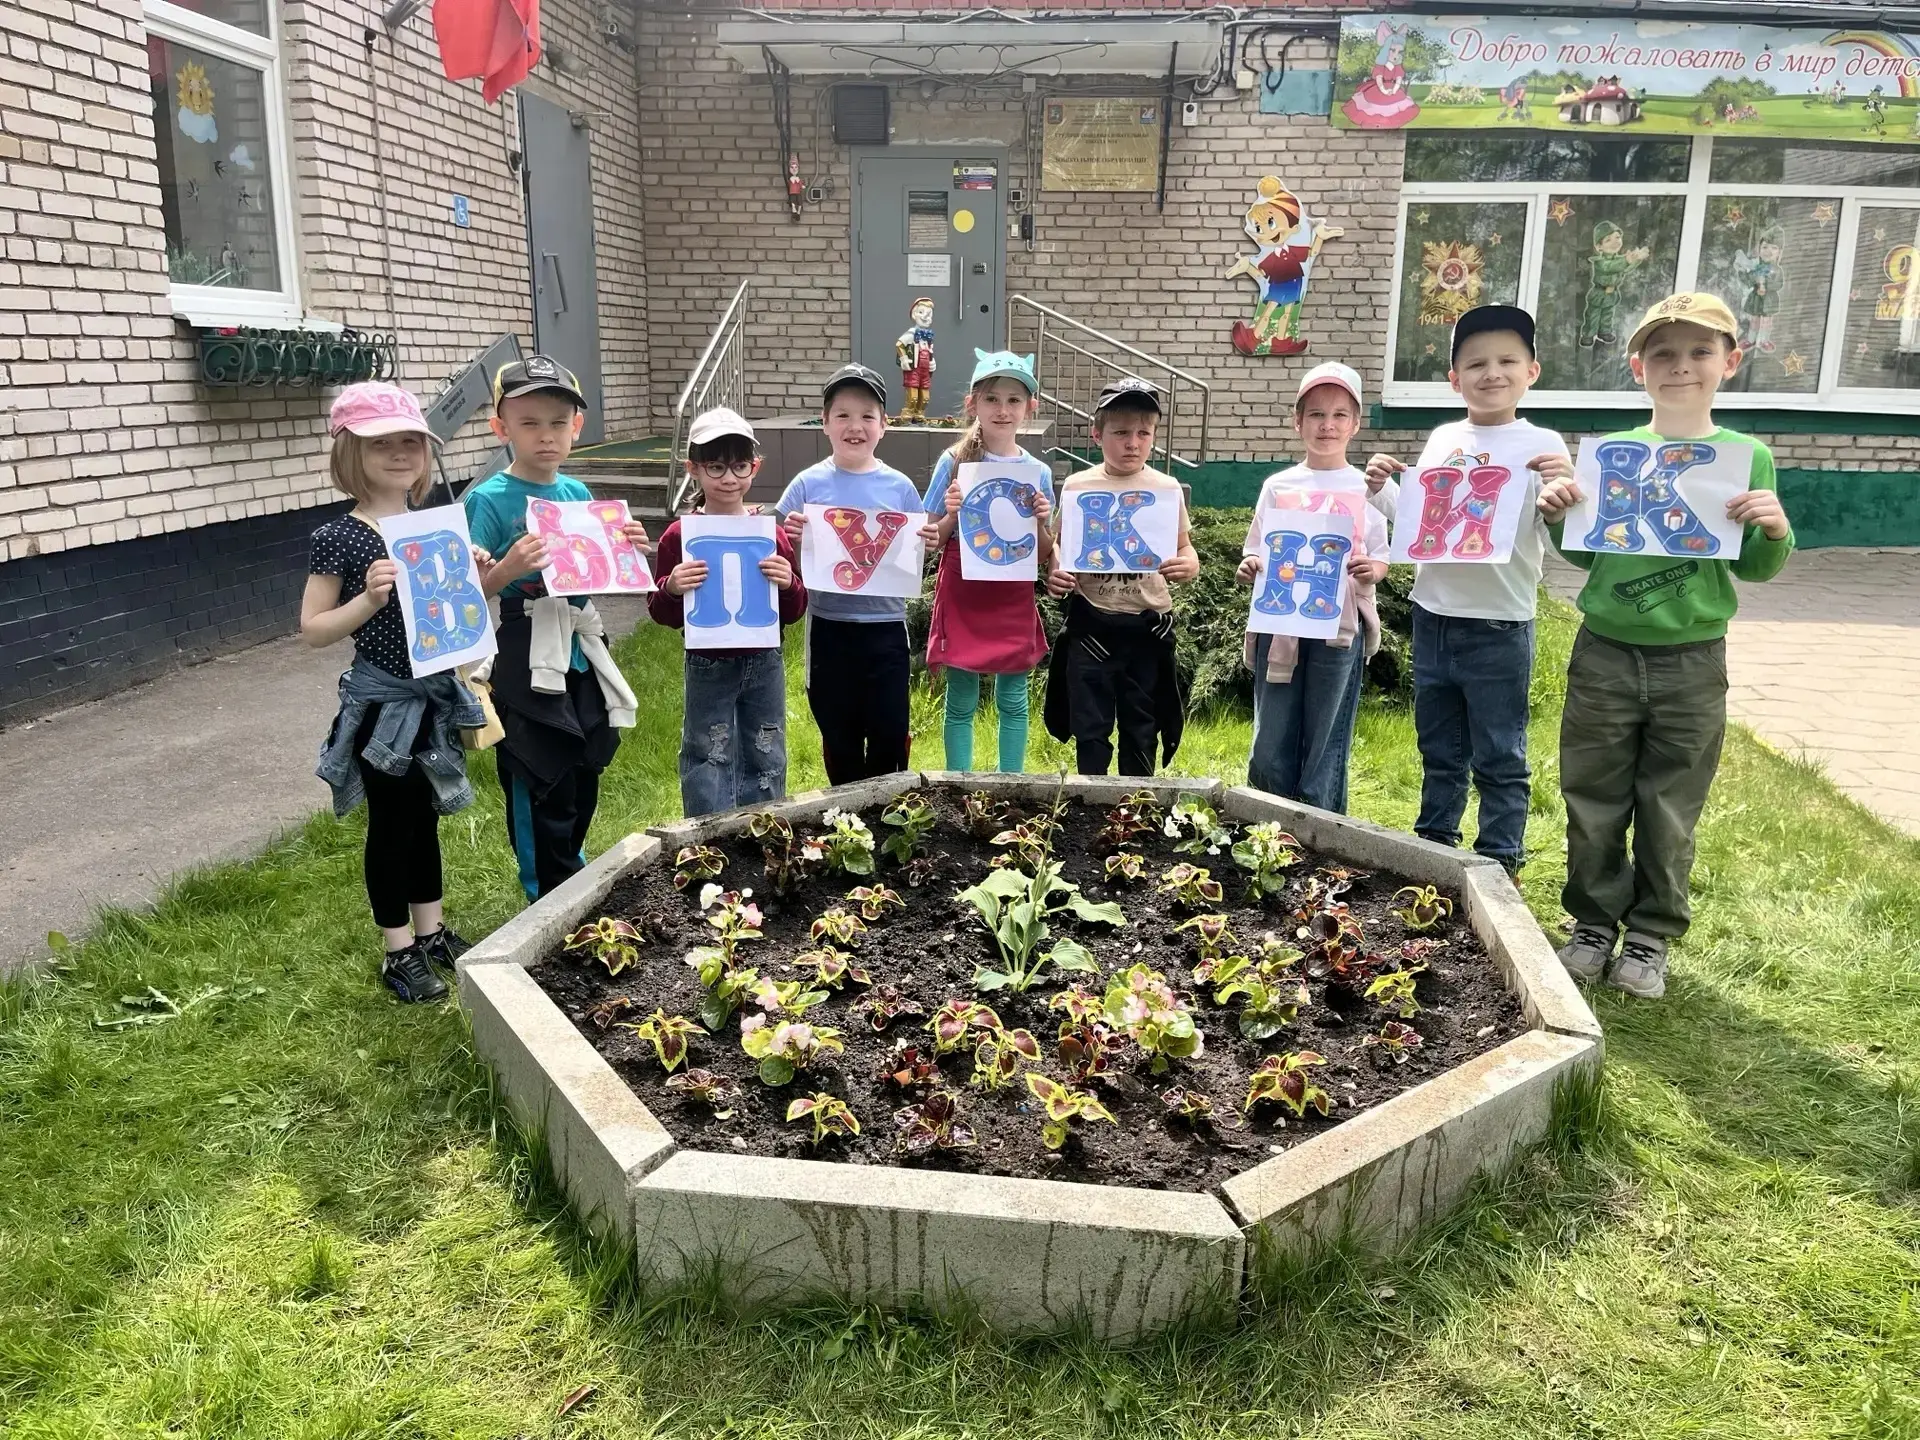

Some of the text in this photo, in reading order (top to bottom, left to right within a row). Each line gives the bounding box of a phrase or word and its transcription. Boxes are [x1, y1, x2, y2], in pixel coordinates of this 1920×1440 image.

[1450, 27, 1920, 82] Добро пожаловать в мир детс
[1419, 313, 1461, 326] 1941-1
[962, 478, 1036, 566] С
[1074, 491, 1162, 570] К
[1408, 466, 1511, 560] И
[1584, 441, 1720, 556] К
[531, 500, 650, 592] Ы
[685, 536, 778, 628] П
[824, 508, 908, 591] У
[1254, 530, 1351, 620] Н
[1625, 565, 1691, 595] SKATE ONE
[392, 529, 487, 662] В
